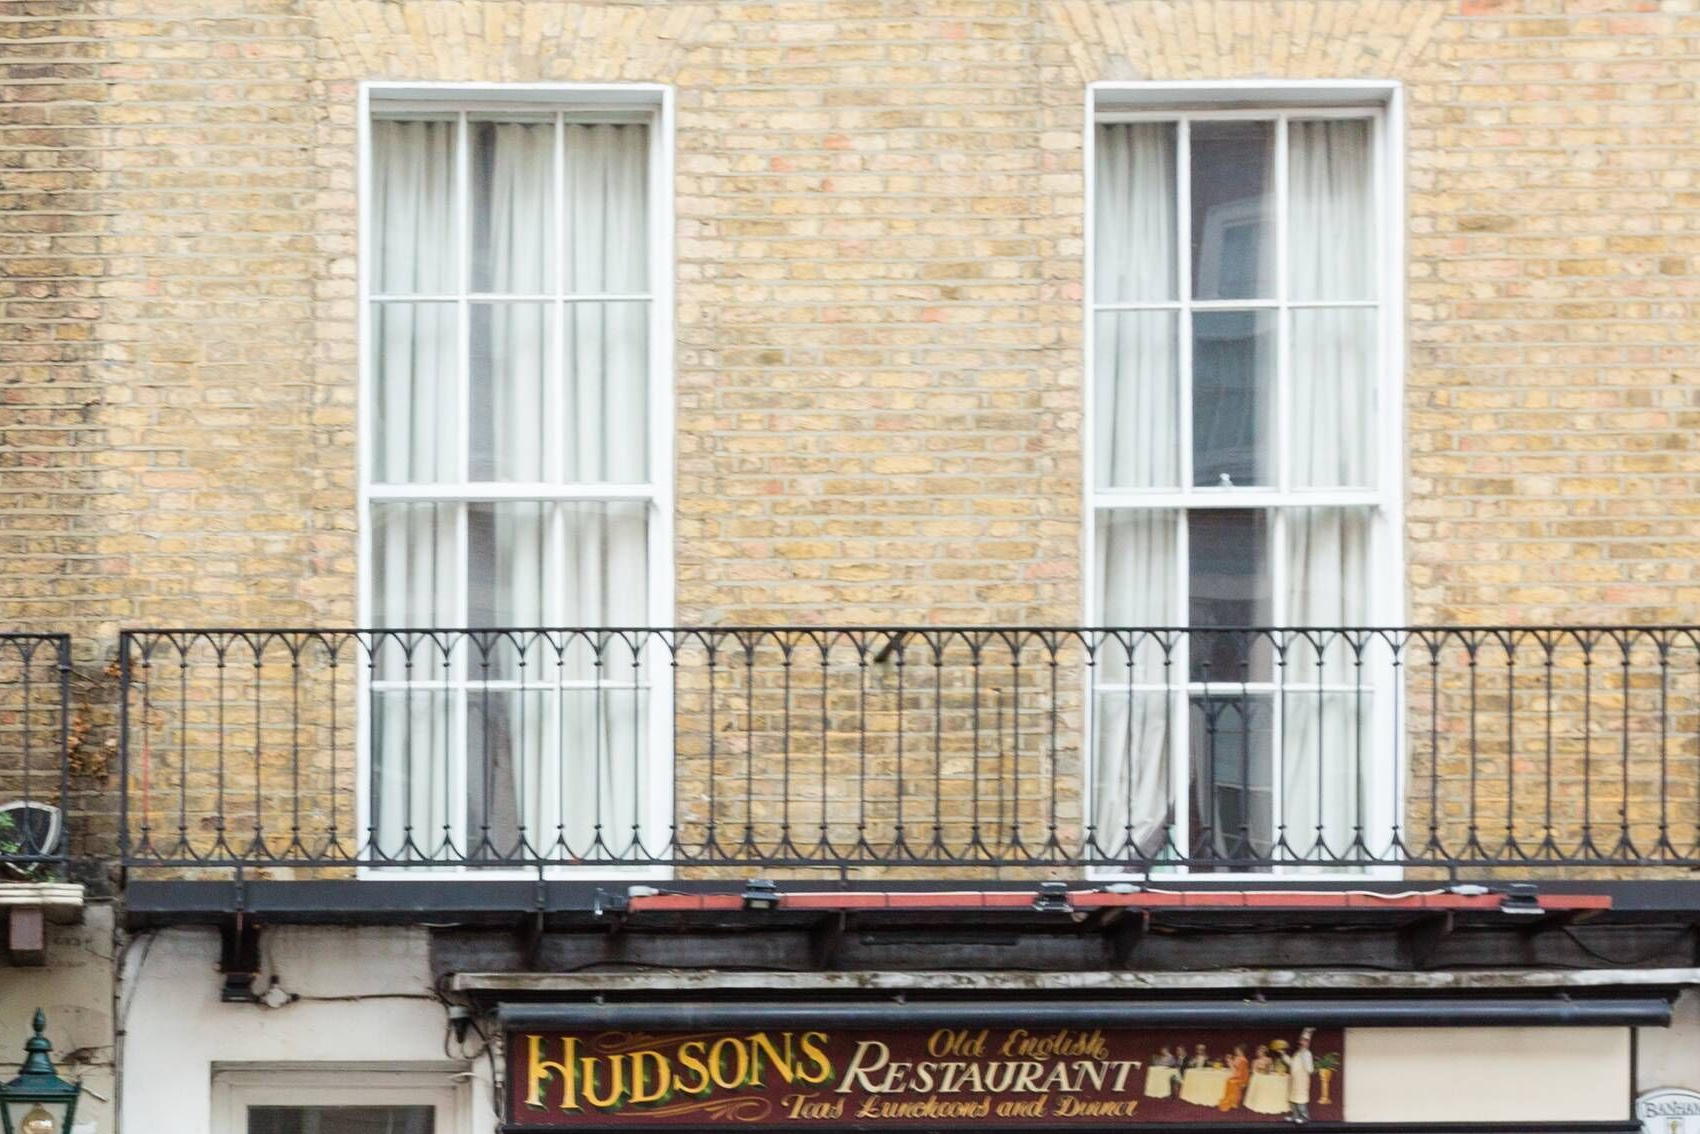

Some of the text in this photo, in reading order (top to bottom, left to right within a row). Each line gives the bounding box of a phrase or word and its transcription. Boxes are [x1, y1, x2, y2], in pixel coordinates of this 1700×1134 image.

[928, 1029, 1109, 1061] Old English
[525, 1031, 1142, 1111] HUDSONS RESTAURANT
[782, 1094, 1139, 1119] Teas Luncheons and Dinner
